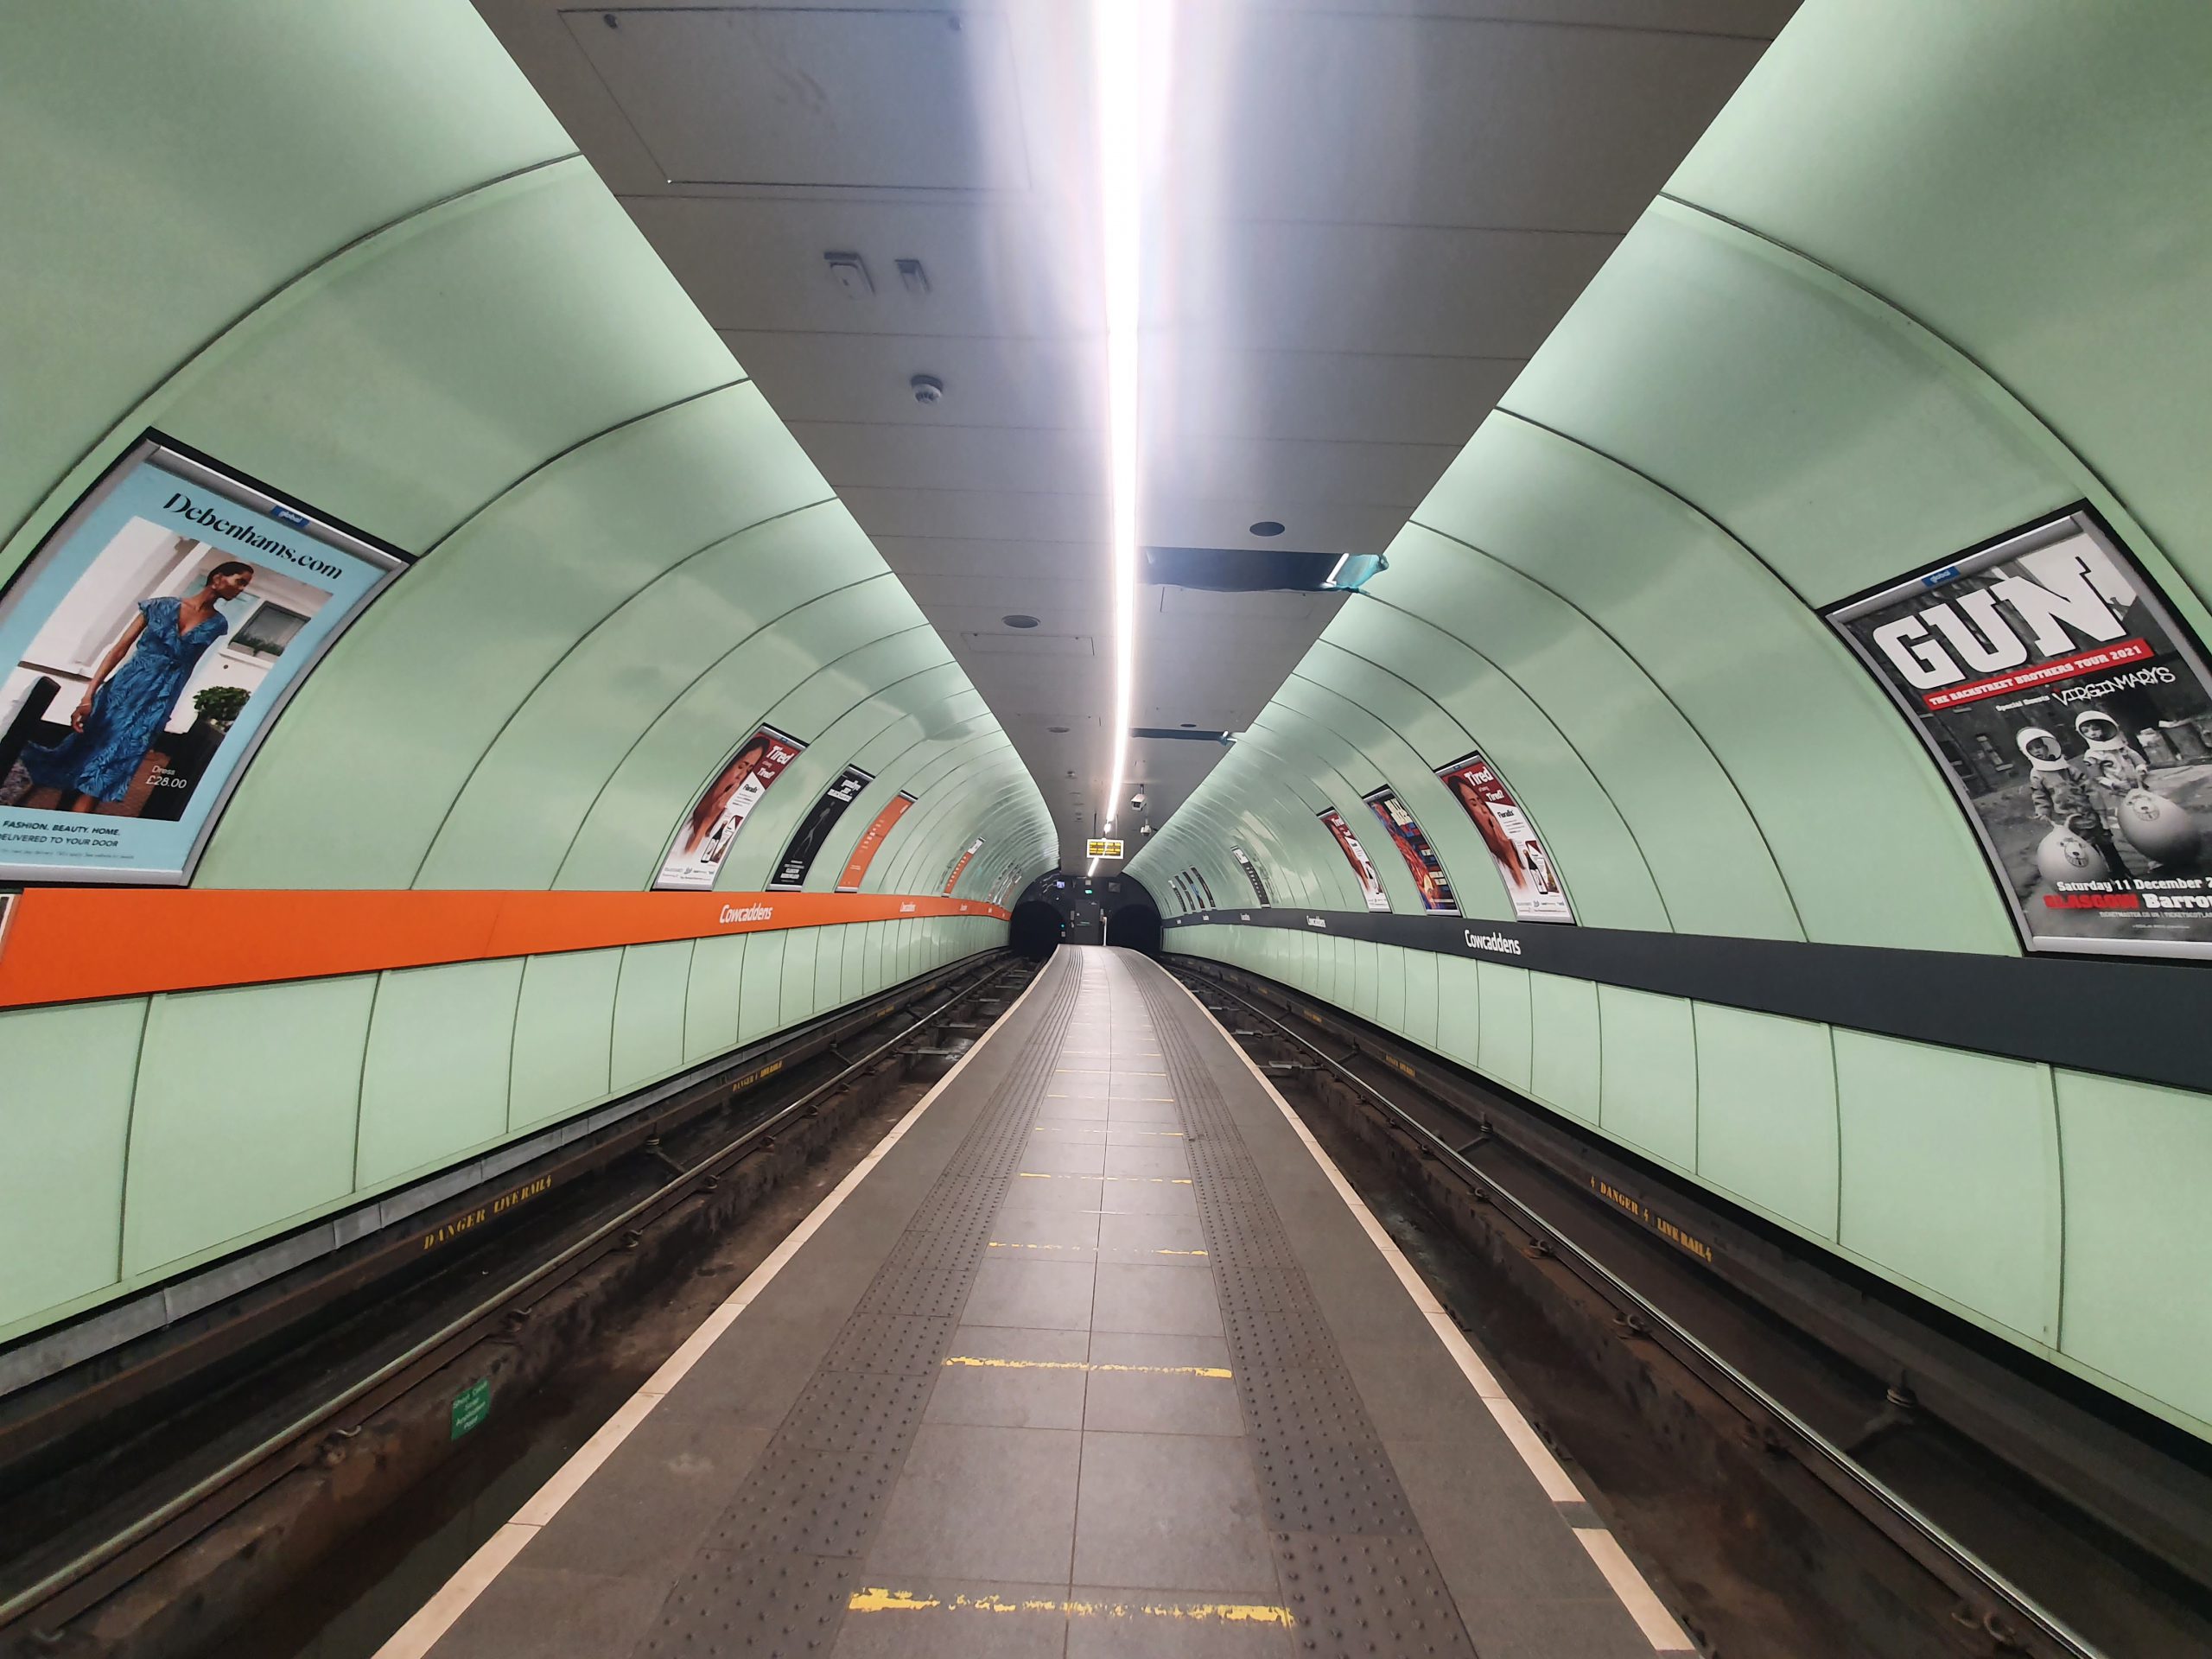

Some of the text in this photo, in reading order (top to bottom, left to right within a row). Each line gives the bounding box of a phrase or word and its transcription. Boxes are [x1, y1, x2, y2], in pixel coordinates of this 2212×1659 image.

[162, 493, 343, 580] Debenhams.com
[1872, 555, 2127, 690] GUN
[1929, 645, 2142, 705] THE BACKSTREET BROTHERS TOUR 2021
[2051, 666, 2176, 706] VIRGINMARYS
[766, 745, 795, 765] Tired
[145, 775, 188, 788] £28.00
[151, 765, 175, 775] Dress
[1464, 766, 1494, 786] Tired
[2, 820, 120, 836] FASHION. BEAUTY. HOME.
[2056, 880, 2113, 892] Saturday
[2114, 879, 2132, 890] 11
[2132, 877, 2203, 891] December
[719, 901, 773, 924] Cowcaddens
[2044, 893, 2139, 910] GLASGOW
[1464, 929, 1522, 956] Cowcaddens
[423, 1179, 546, 1250] DANGER LIVE RAIL
[1600, 1181, 1706, 1258] DANGER LIVE RAIL
